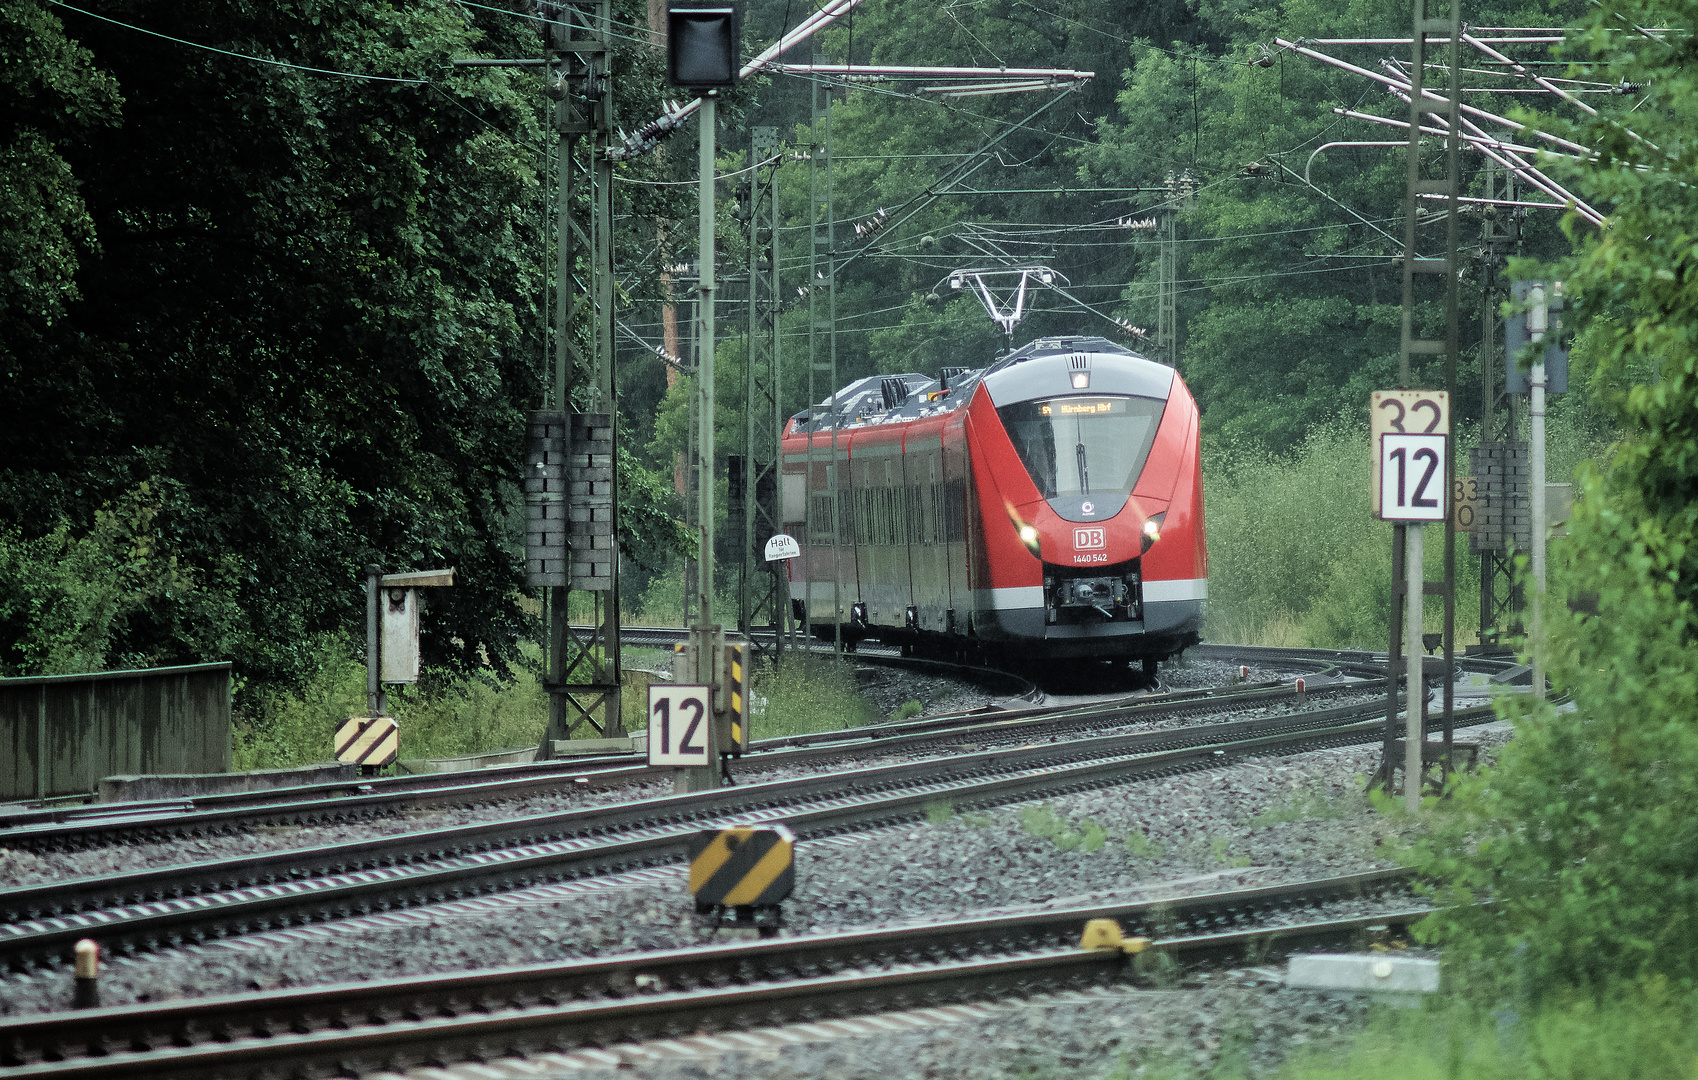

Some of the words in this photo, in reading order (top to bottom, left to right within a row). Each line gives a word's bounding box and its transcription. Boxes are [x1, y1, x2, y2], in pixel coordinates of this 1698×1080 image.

[1097, 402, 1112, 412] Hbf
[1379, 398, 1441, 433] 32
[1389, 447, 1439, 508] 12
[1454, 480, 1478, 502] 33
[1458, 505, 1474, 527] 0
[770, 537, 791, 548] Halt
[1077, 531, 1102, 547] DB
[1073, 554, 1091, 563] 1440
[1092, 553, 1108, 562] 542
[653, 697, 704, 755] 12
